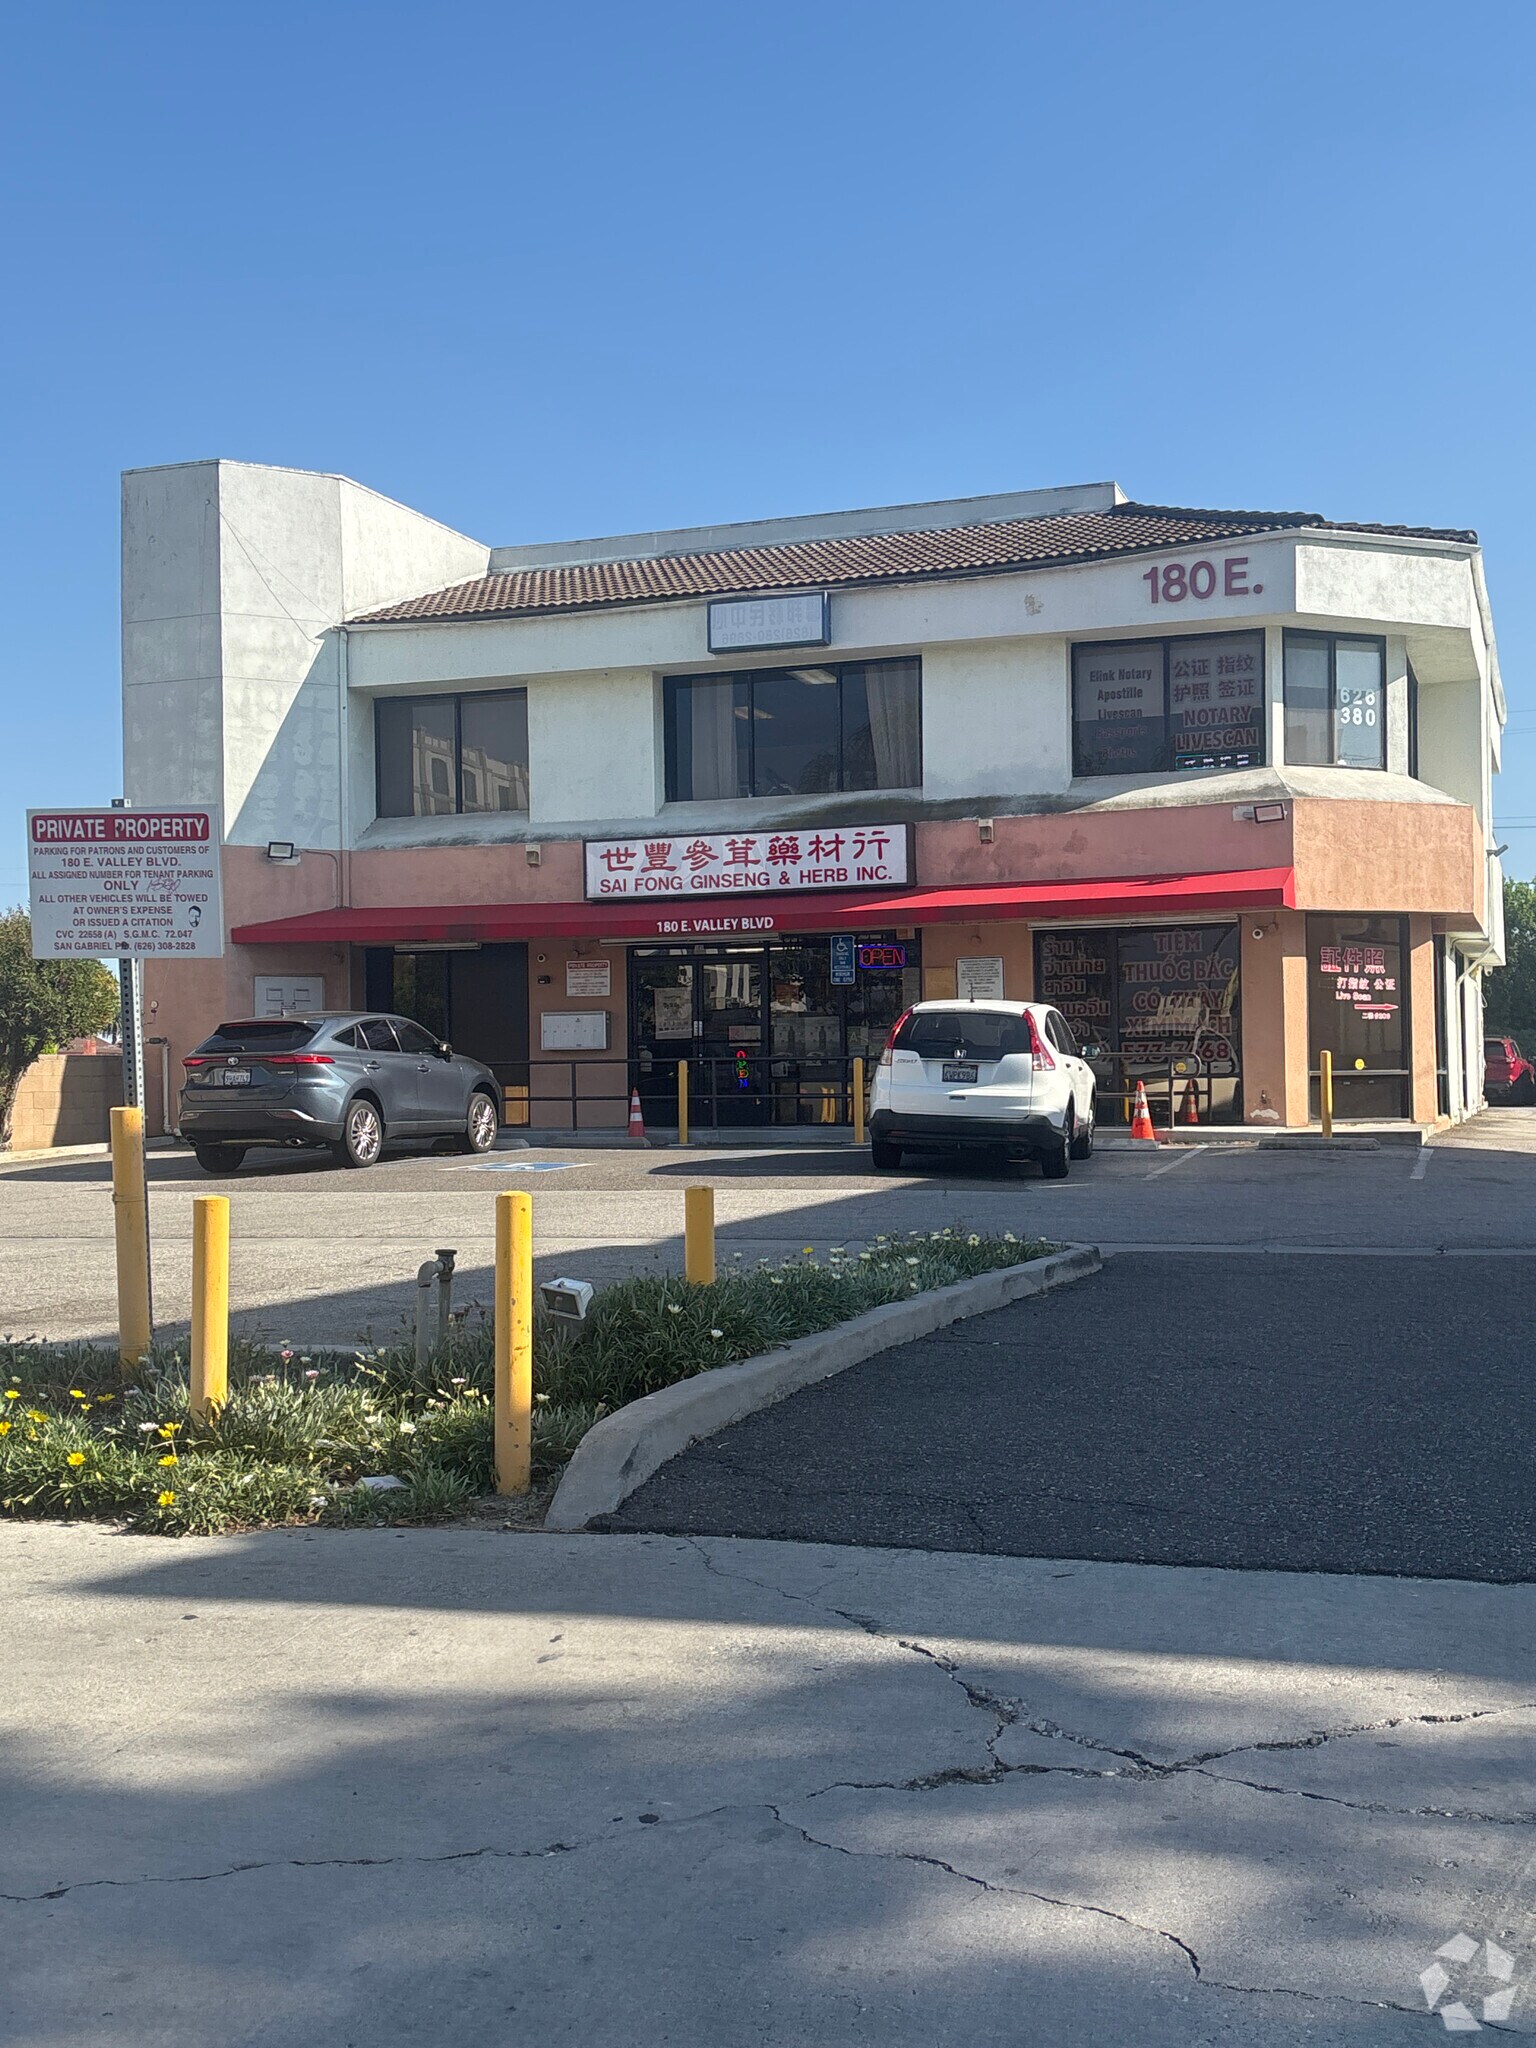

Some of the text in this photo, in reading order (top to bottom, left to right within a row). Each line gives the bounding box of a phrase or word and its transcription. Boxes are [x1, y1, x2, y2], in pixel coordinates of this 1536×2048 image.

[1143, 557, 1263, 604] 180 E.
[1118, 668, 1152, 681] Notary
[1174, 654, 1254, 677] 公证 指纹
[1098, 687, 1143, 702] Apostille
[1174, 679, 1254, 702] 护照 签证
[1340, 688, 1376, 706] 626
[1098, 708, 1142, 720] Livescan
[1184, 706, 1251, 727] NOTARY
[1340, 708, 1376, 727] 380
[1176, 728, 1258, 752] LIVESCAN
[36, 818, 205, 838] PRIVATE PROPERTY
[146, 846, 196, 854] CUSTOMERS
[62, 857, 181, 867] 180 E. VALLEY BLVD.
[32, 871, 46, 879] ALL
[49, 871, 87, 879] ASSIGNED
[177, 870, 213, 878] PARKING
[600, 866, 892, 893] SAI FONG GINSENG & HERB INC.
[104, 881, 139, 890] ONLY
[39, 895, 55, 903] ALL
[57, 895, 87, 903] OTHER
[175, 894, 208, 902] TOWED
[656, 917, 774, 932] 180 E. VALLEY BLVD
[134, 942, 155, 951] (626)
[157, 942, 196, 950] 308-2828
[1154, 928, 1202, 955] TIỆM
[861, 948, 903, 965] OPEN
[1124, 953, 1233, 983] THUỐC BẮC
[1133, 986, 1162, 1012] CÓ
